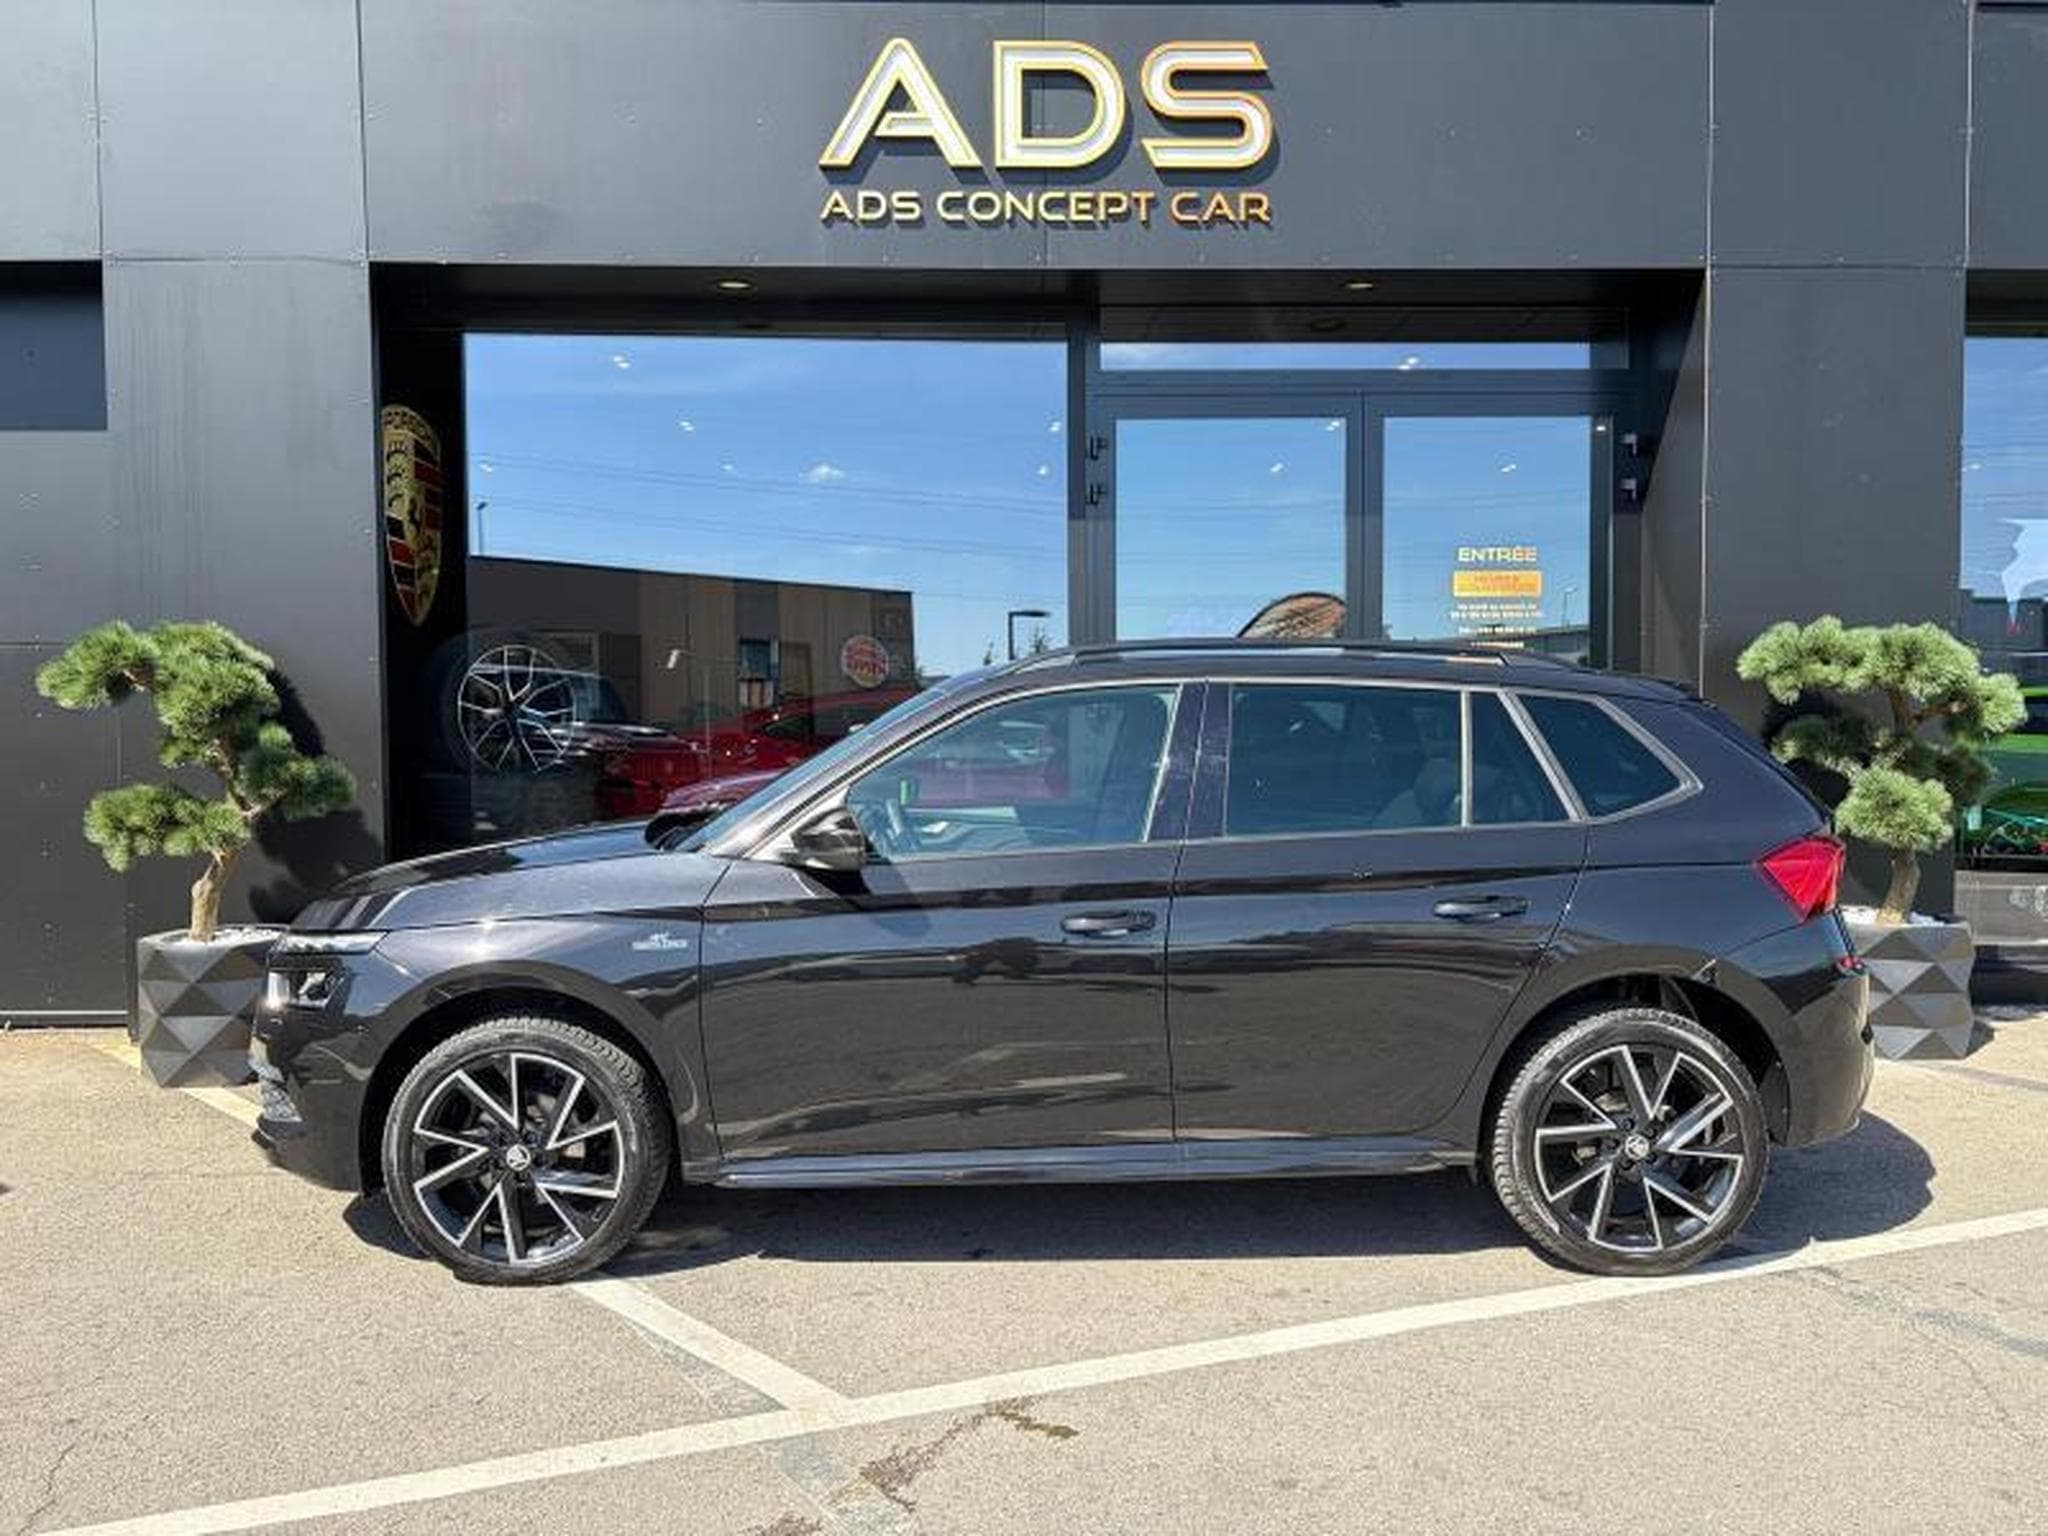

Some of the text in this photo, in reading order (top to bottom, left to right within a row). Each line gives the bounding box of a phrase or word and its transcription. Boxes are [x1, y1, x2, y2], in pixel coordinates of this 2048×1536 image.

[819, 37, 1273, 169] ADS
[820, 190, 1271, 223] ADS CONCEPT CAR
